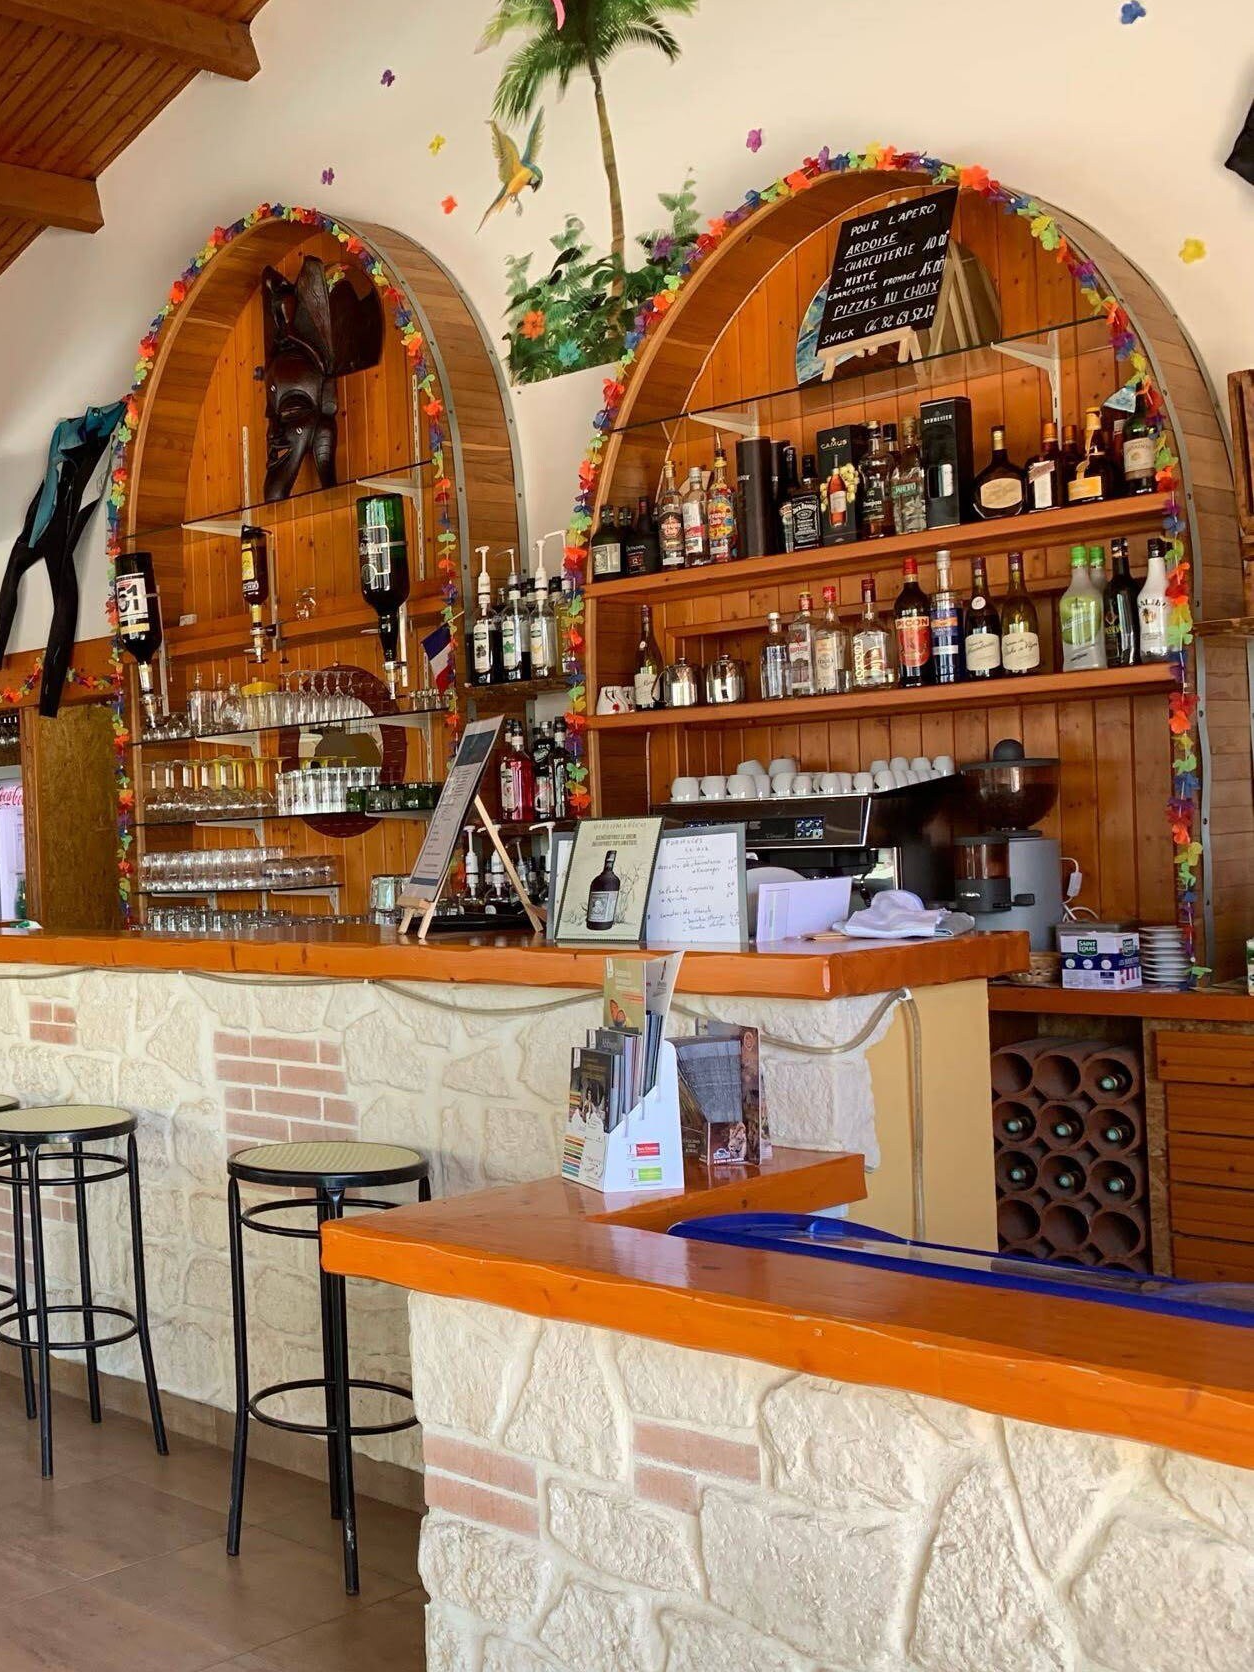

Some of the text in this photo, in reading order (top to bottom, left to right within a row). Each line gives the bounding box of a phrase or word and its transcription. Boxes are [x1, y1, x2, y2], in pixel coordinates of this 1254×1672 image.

[850, 219, 880, 237] POUR
[845, 231, 899, 257] ARDOISE
[828, 282, 878, 301] CHARCUTERIE
[882, 270, 917, 287] FROMAGE
[844, 270, 878, 288] MIXTE
[833, 279, 940, 318] PIZZAS AU CHOIX
[821, 328, 855, 345] SNACK
[117, 584, 140, 613] 51
[896, 617, 929, 627] PICON
